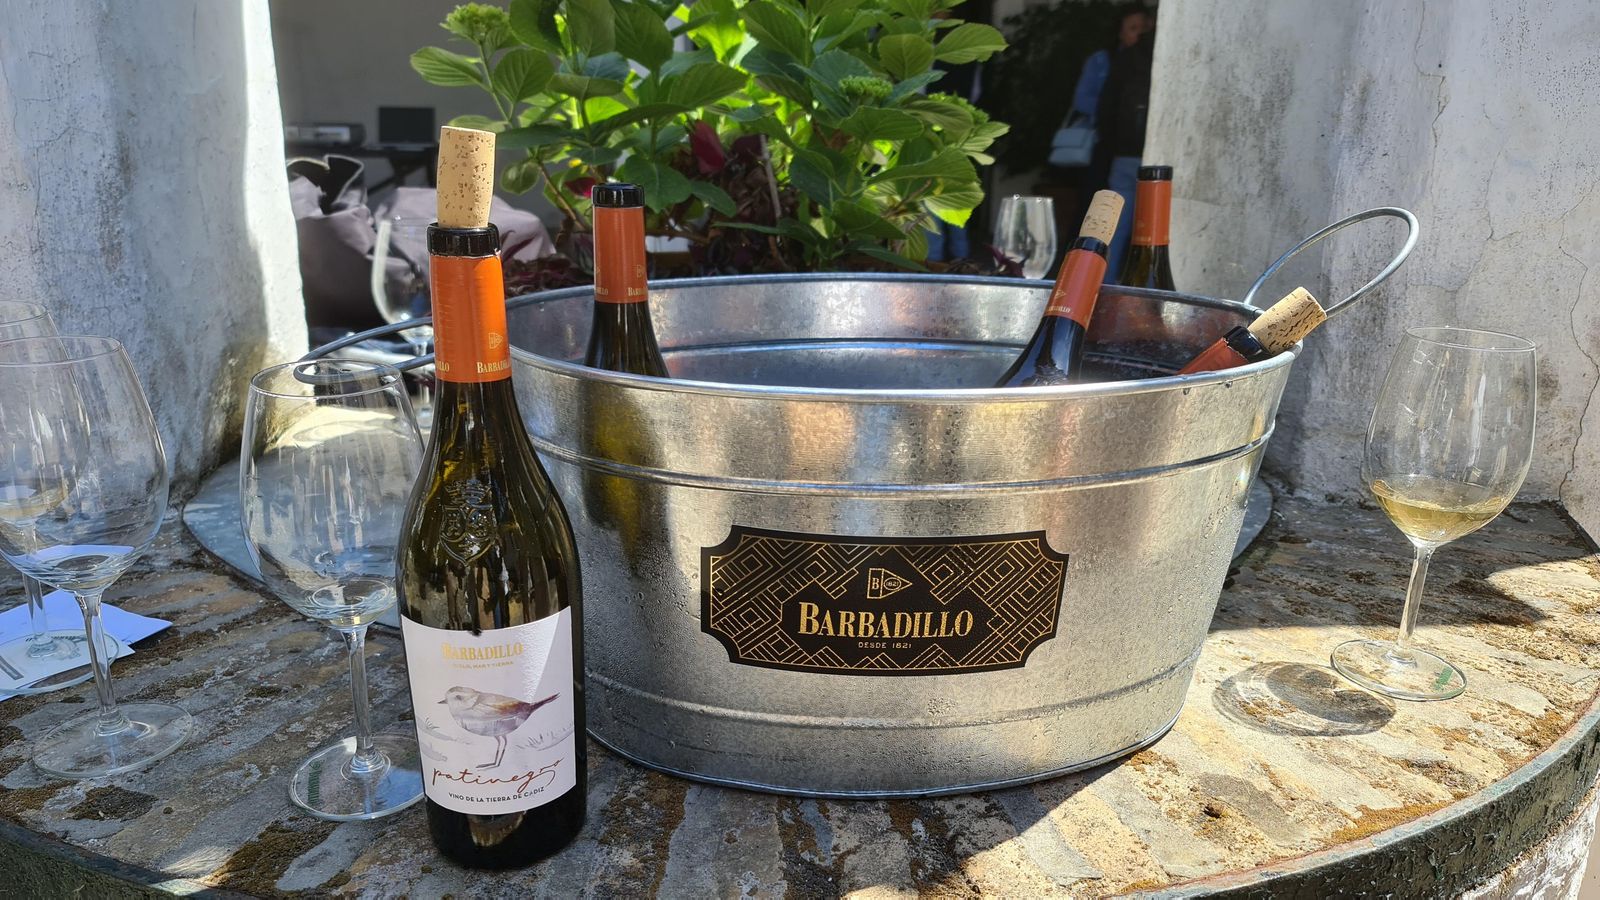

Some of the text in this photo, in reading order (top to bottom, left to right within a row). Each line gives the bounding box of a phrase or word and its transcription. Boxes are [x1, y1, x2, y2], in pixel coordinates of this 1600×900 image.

[871, 577, 881, 590] B
[797, 601, 974, 638] BARBADILLO
[441, 641, 524, 660] BARBADILLO
[858, 641, 912, 649] DESDE 1821
[448, 792, 464, 801] VINO
[486, 795, 511, 803] TIERRA
[512, 792, 523, 800] DE
